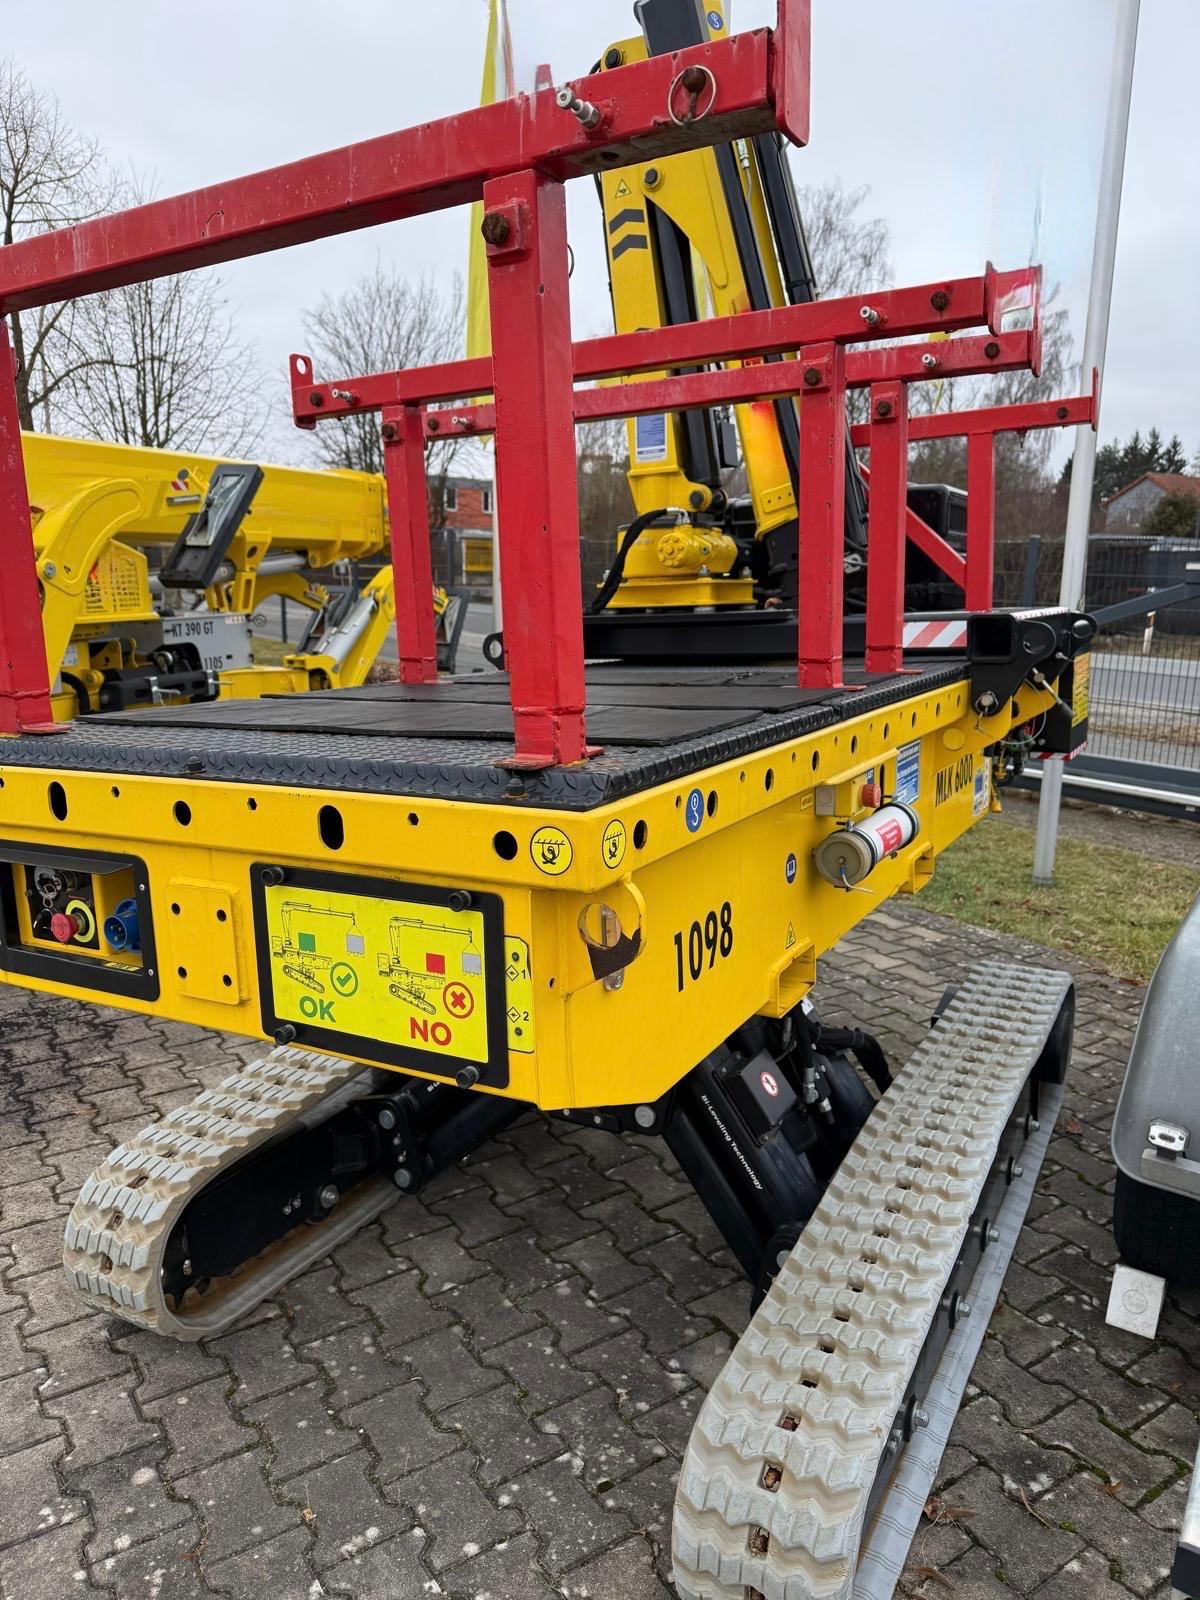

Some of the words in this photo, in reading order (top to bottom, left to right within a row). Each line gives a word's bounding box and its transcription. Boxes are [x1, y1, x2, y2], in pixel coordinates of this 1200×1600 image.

[172, 624, 183, 638] KT
[185, 622, 201, 637] 390
[203, 621, 214, 635] GT
[204, 656, 223, 670] 1105
[935, 764, 954, 808] MLK
[674, 901, 733, 993] 1098
[521, 969, 526, 979] 1
[300, 996, 336, 1023] OK
[522, 1011, 529, 1021] 2
[410, 1017, 452, 1046] NO
[701, 1095, 732, 1142] Bi-Leveling
[730, 1141, 763, 1190] Technology
